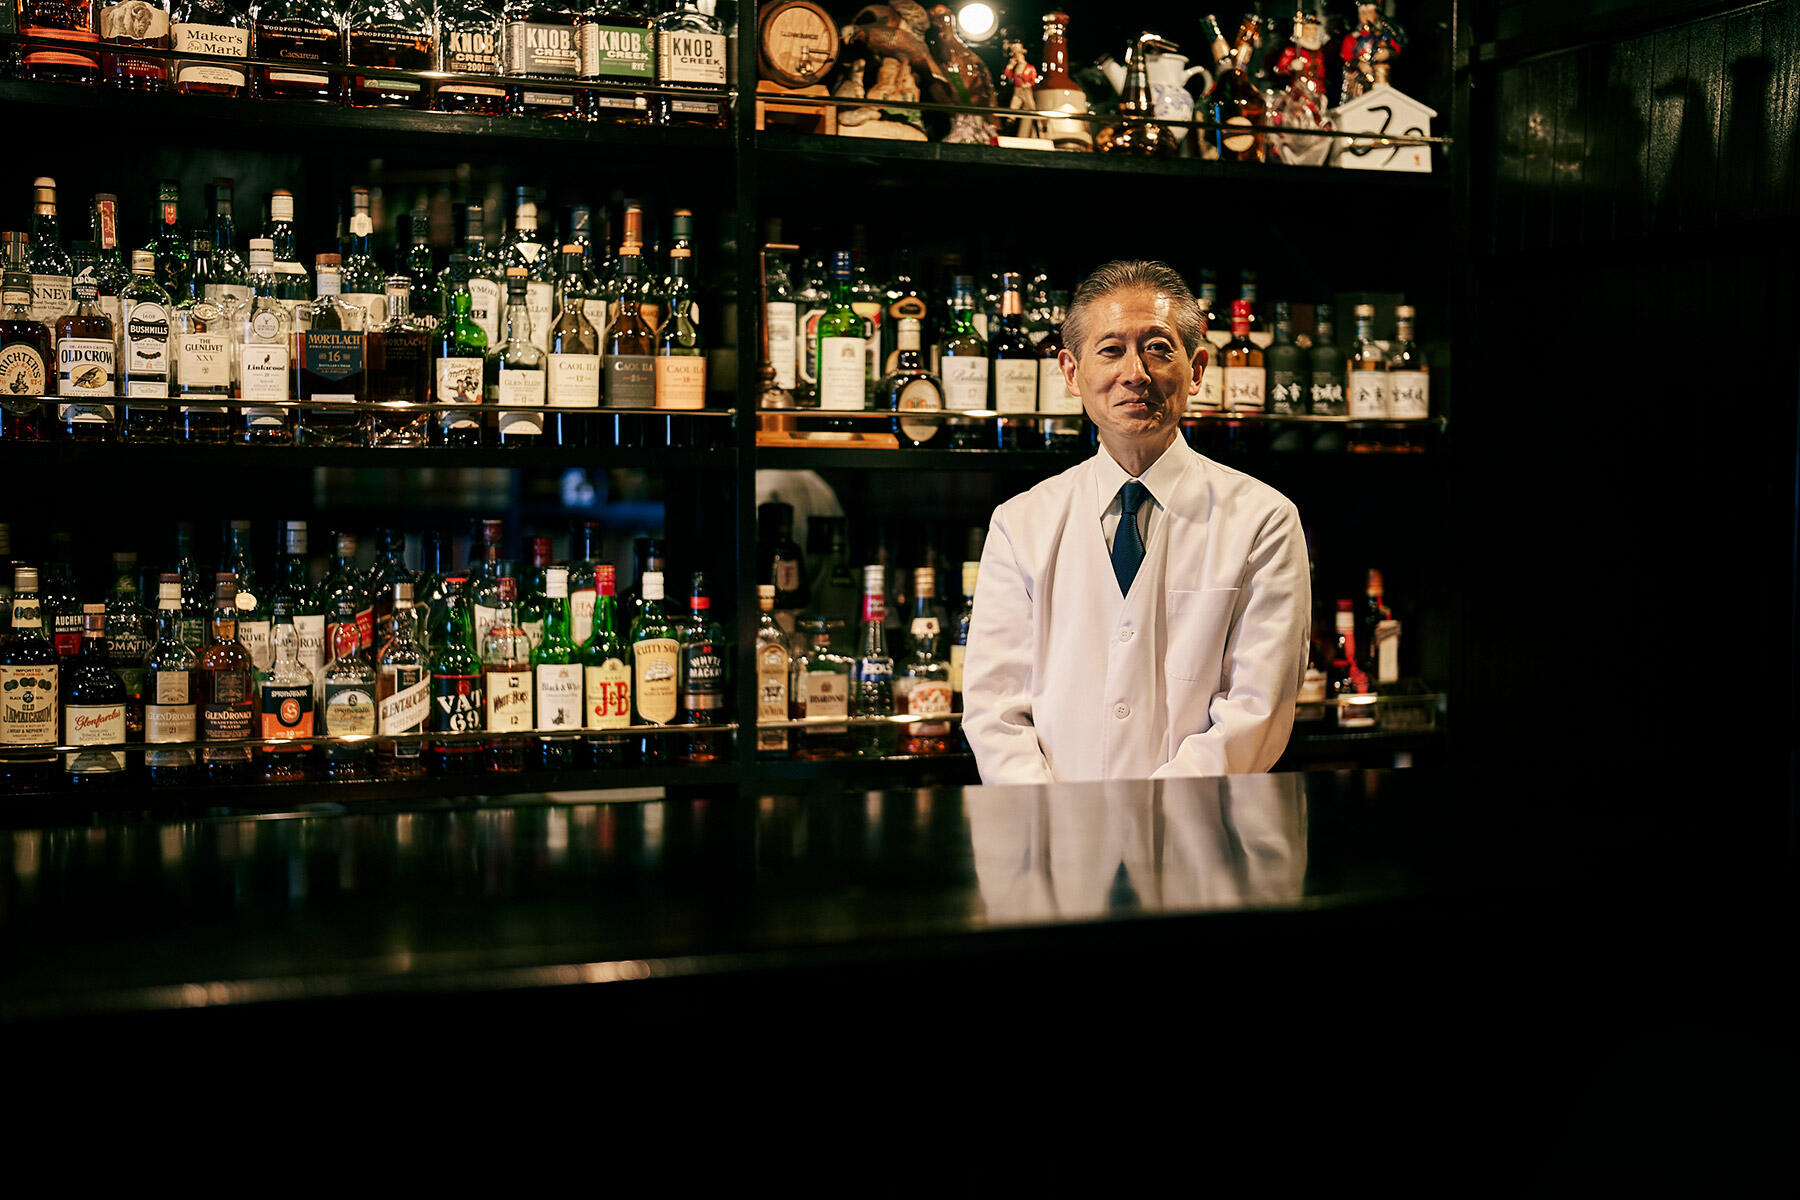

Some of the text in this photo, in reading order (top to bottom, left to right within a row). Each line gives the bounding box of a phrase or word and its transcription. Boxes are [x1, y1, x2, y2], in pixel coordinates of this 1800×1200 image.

[263, 25, 302, 33] WOODFORD
[187, 30, 243, 44] Maker's
[527, 28, 570, 50] KNOB
[600, 31, 641, 52] KNOB
[450, 32, 493, 54] KNOB
[673, 38, 712, 57] KNOB
[203, 44, 243, 56] Mark
[535, 48, 578, 58] CREEK
[607, 50, 649, 60] CREEK
[631, 62, 646, 71] RYE
[680, 57, 720, 66] CREEK
[467, 63, 485, 72] 2001
[130, 324, 168, 335] BUSHMILLS
[308, 333, 361, 345] MORTLACH
[185, 344, 223, 352] GLENLIVET
[61, 350, 112, 365] OLD CROW
[328, 351, 341, 362] 16
[107, 640, 152, 650] OMATIN
[437, 688, 482, 714] VAT
[22, 703, 35, 711] OLD
[511, 716, 519, 725] 12
